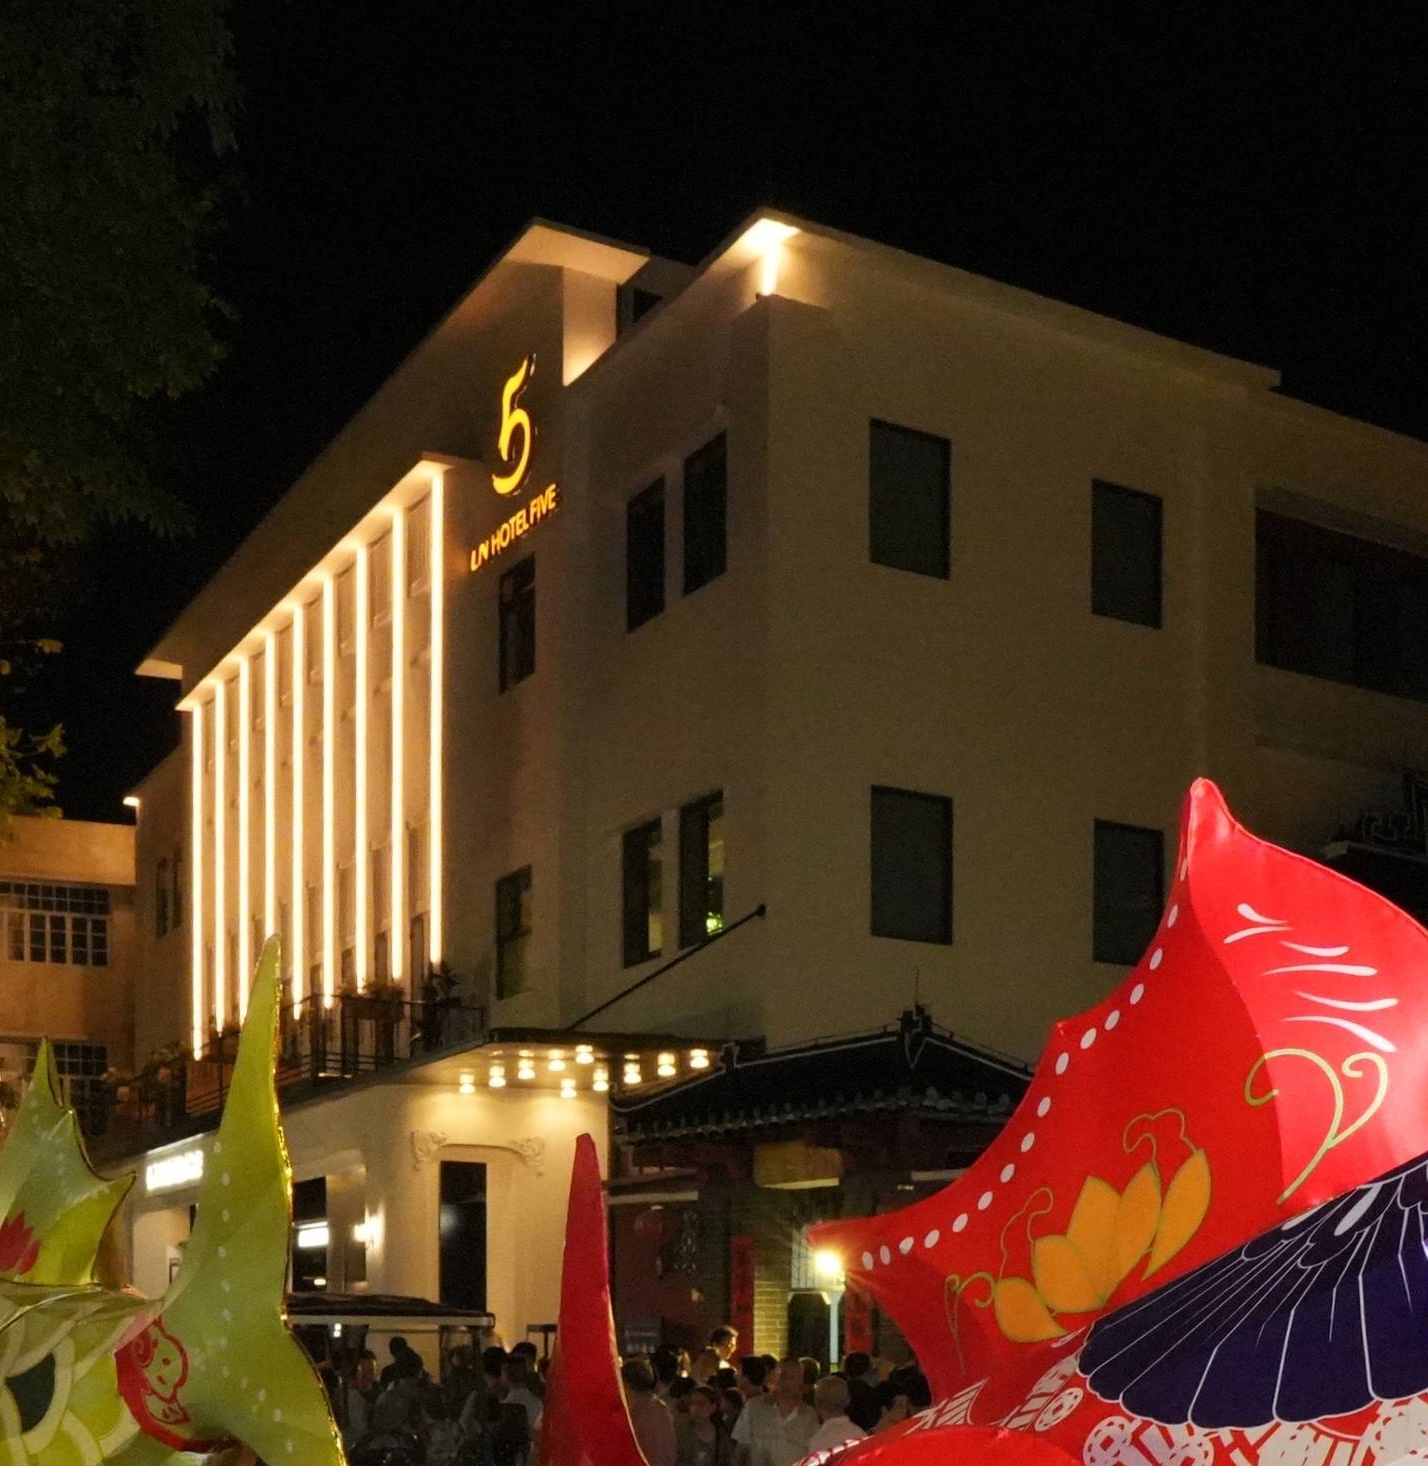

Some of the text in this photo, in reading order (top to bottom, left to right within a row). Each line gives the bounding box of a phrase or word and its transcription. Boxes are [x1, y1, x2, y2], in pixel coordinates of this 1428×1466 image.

[492, 357, 532, 495] 5
[491, 508, 529, 554] HOTEL
[530, 484, 557, 525] FIVE
